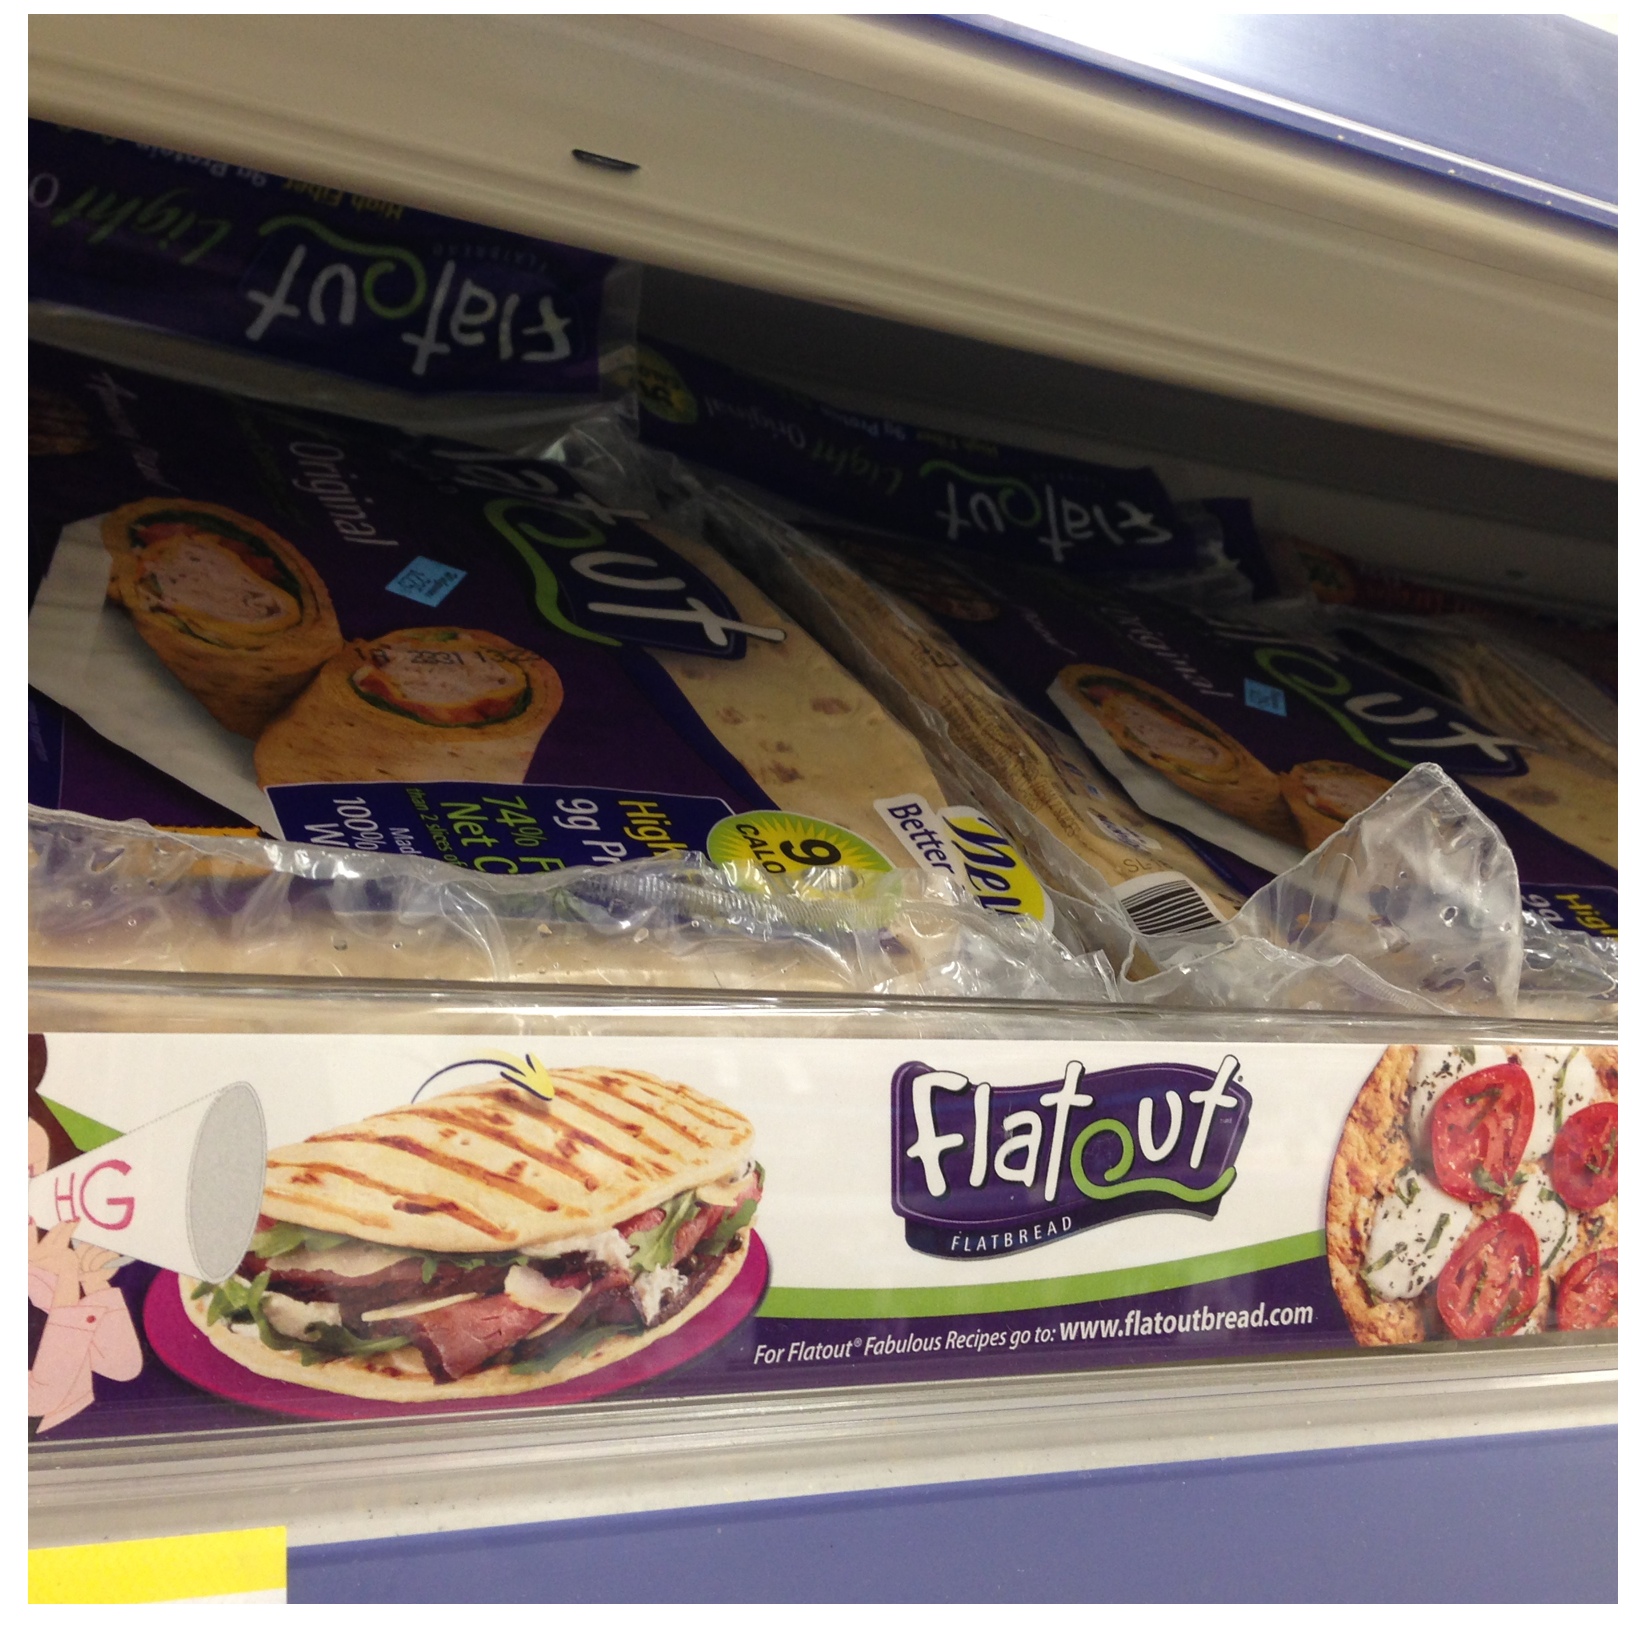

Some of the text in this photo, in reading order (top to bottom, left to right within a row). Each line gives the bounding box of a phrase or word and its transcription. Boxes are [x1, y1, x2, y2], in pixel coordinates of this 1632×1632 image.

[246, 214, 574, 375] Flatout
[288, 440, 400, 548] Original
[430, 449, 787, 648] latout
[332, 795, 388, 852] 100%
[388, 826, 424, 857] Mad
[426, 822, 453, 853] slices
[439, 800, 502, 849] Net
[481, 794, 541, 848] 74%
[552, 797, 601, 832] 9g
[887, 802, 956, 876] Better
[734, 822, 787, 876] CALO
[906, 1053, 1240, 1204] Flatout
[53, 1158, 136, 1232] HG
[950, 1214, 1075, 1253] FLATBREAD
[753, 1343, 786, 1366] For
[863, 1331, 943, 1356] Fabulous
[946, 1326, 1008, 1354] Recipes
[1009, 1329, 1033, 1352] go
[1034, 1324, 1057, 1345] to:
[1059, 1303, 1314, 1343] www.flatoutbread.com
